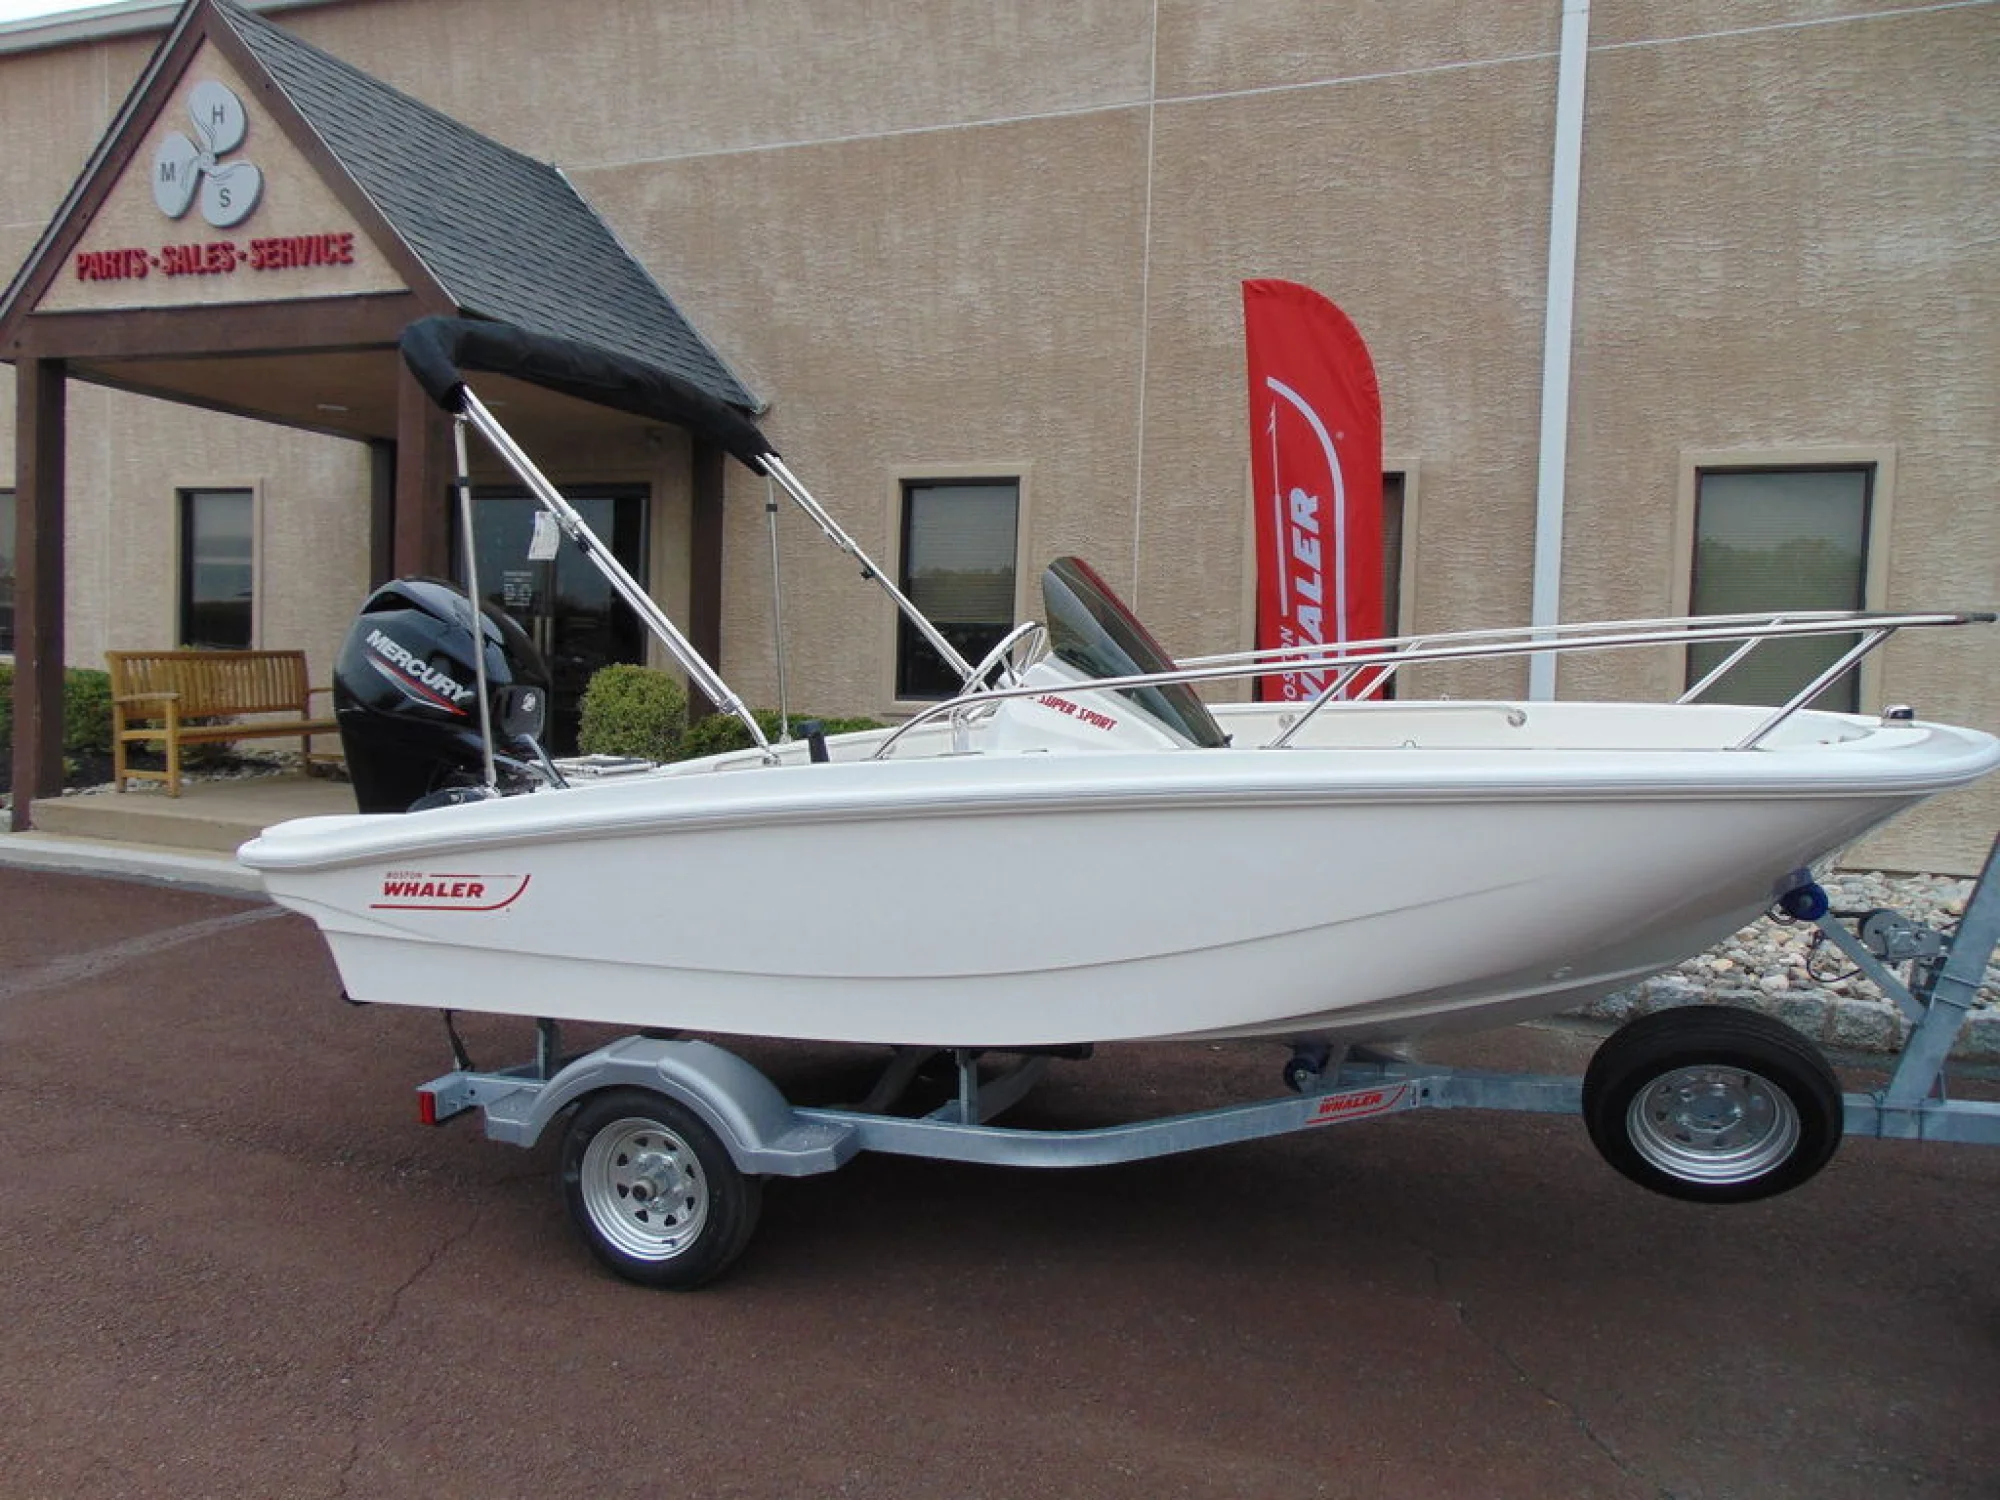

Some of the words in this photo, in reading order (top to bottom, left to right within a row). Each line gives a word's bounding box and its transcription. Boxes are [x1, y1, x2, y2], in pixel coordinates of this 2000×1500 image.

[212, 104, 225, 126] H
[161, 162, 176, 183] M
[219, 187, 232, 208] S
[77, 248, 149, 281] PARTS
[162, 241, 236, 276] SALES
[249, 232, 354, 271] SERVICE
[366, 629, 475, 702] MERCURY
[1077, 708, 1118, 731] SPORT
[385, 871, 423, 880] BOSTON
[384, 882, 485, 899] WHALER
[1319, 1093, 1383, 1113] WHALER
